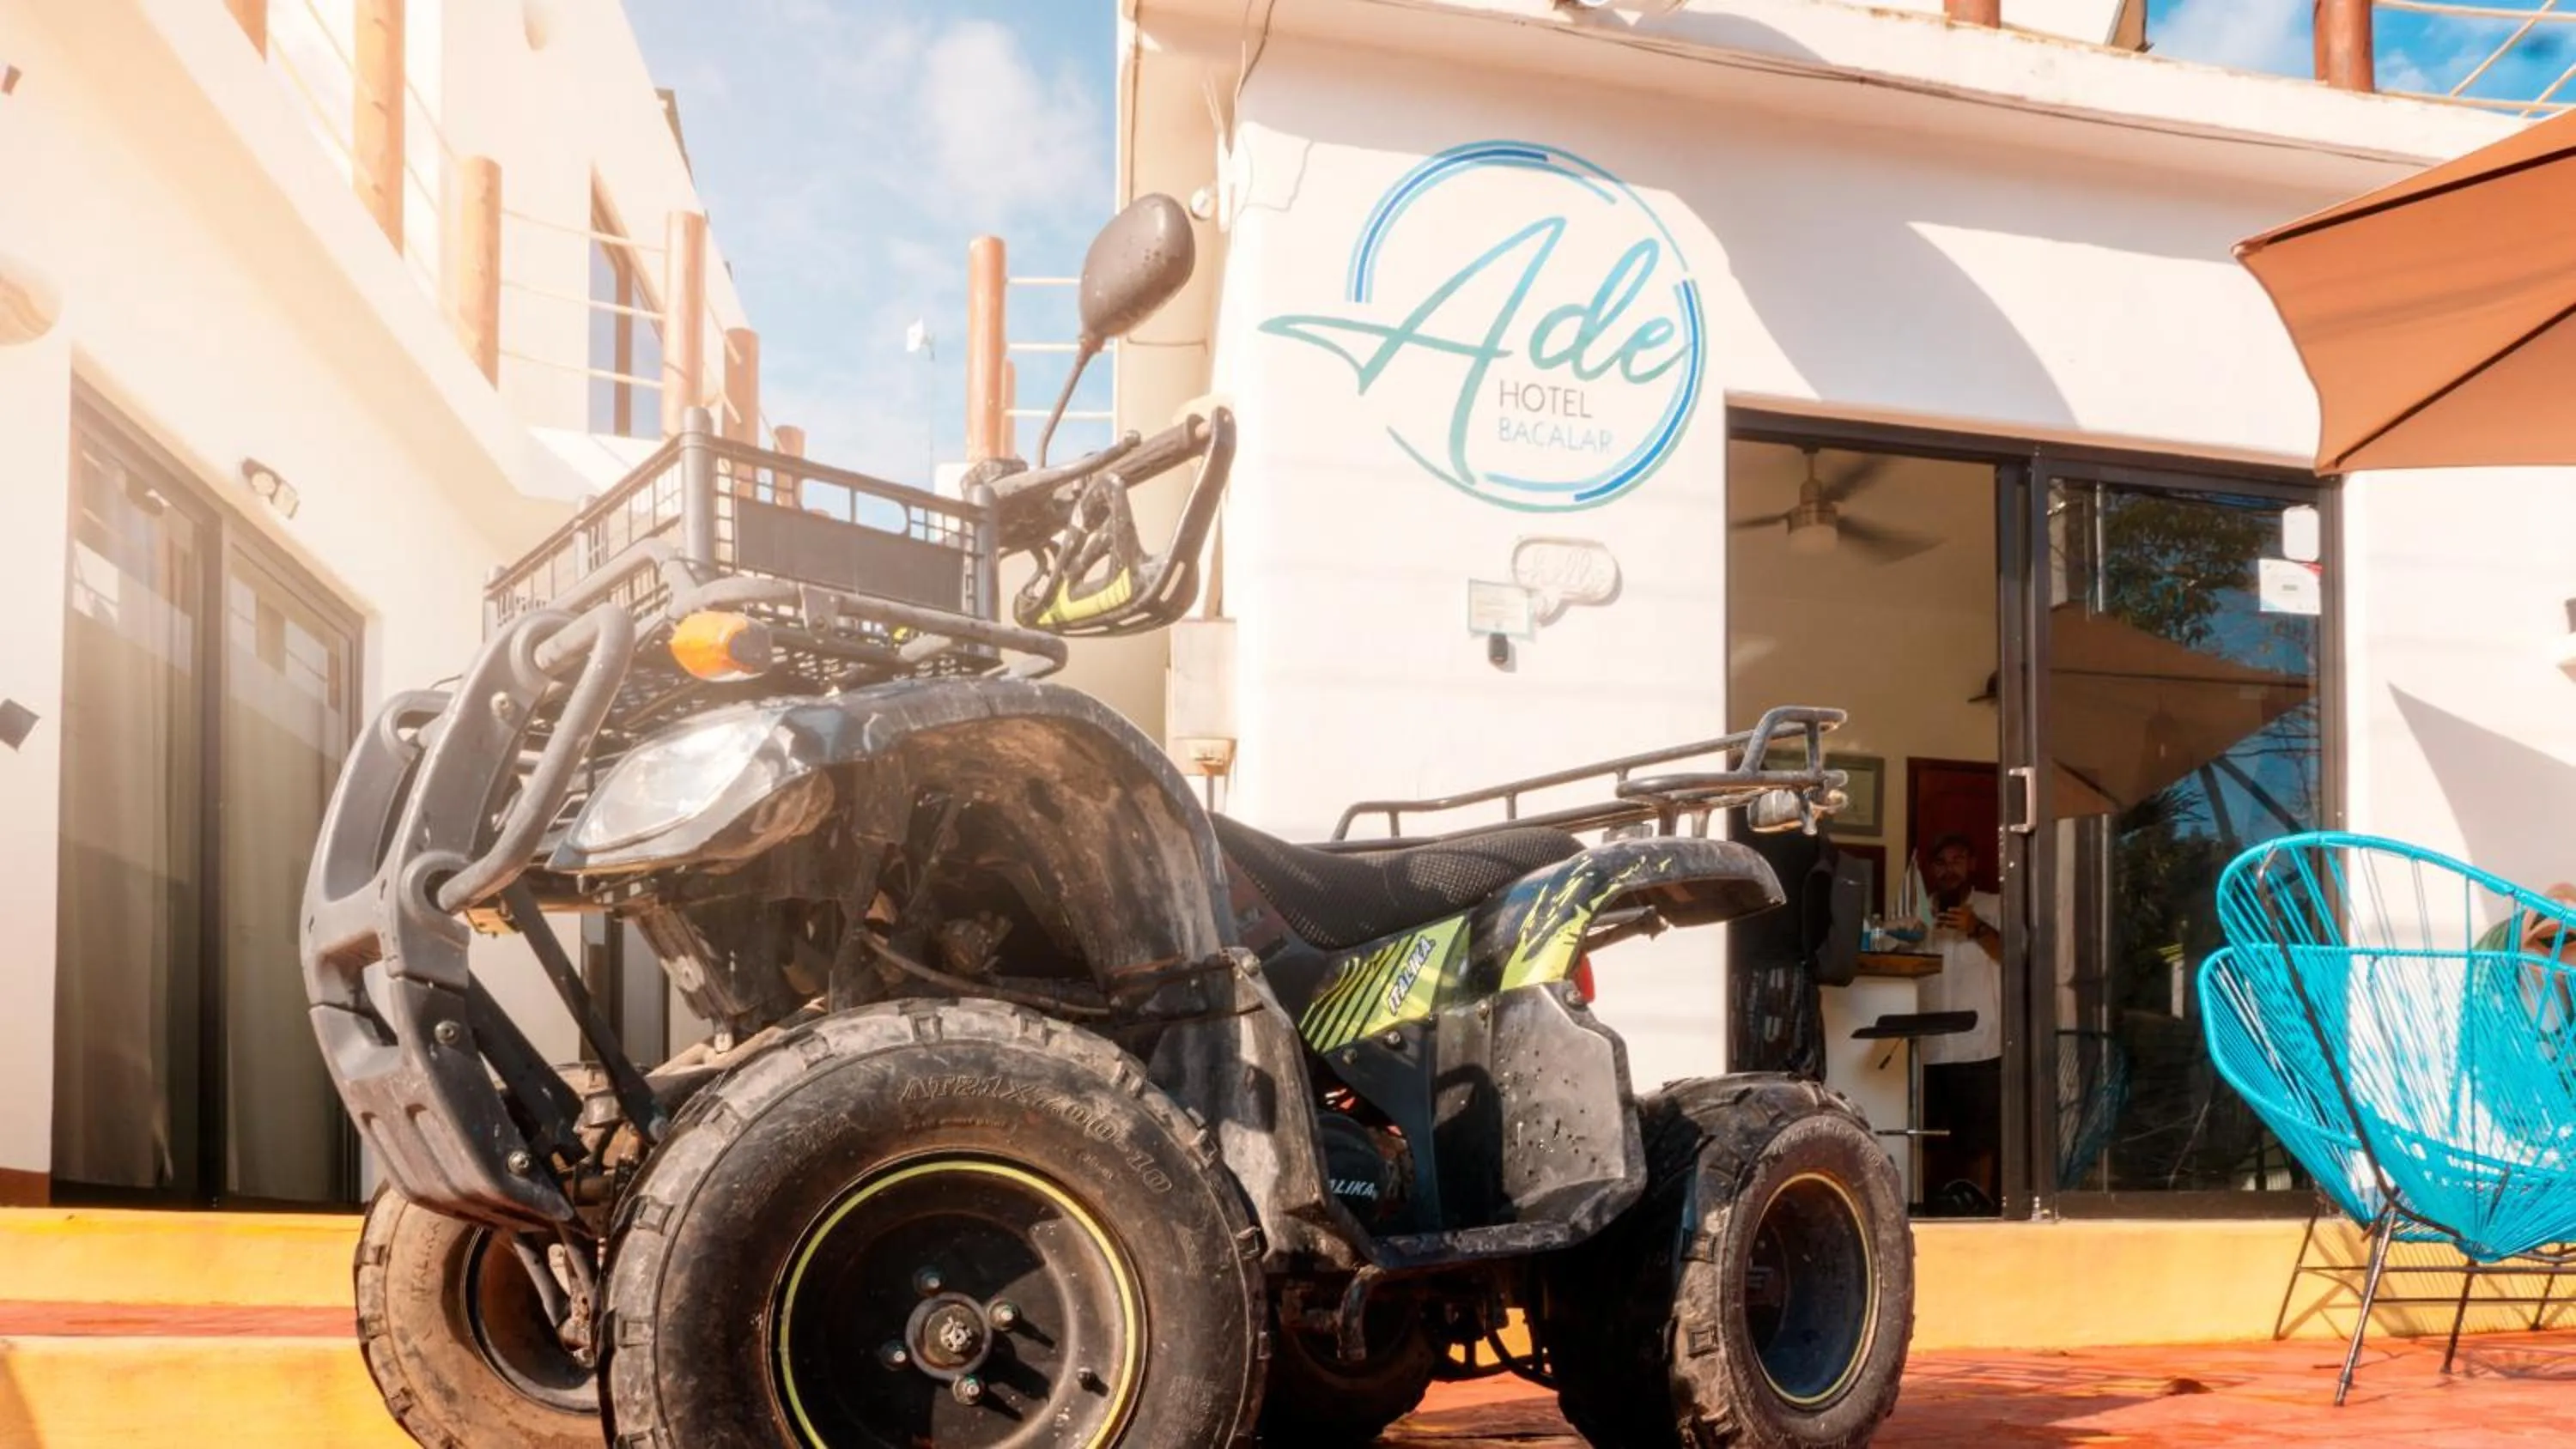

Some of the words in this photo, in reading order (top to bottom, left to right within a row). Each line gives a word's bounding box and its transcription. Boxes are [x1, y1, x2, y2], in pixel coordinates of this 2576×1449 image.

[1257, 215, 1693, 486] Ade
[1498, 379, 1594, 419] HOTEL
[1498, 416, 1613, 454] BACALAR
[1387, 934, 1436, 1016] ITALIKA
